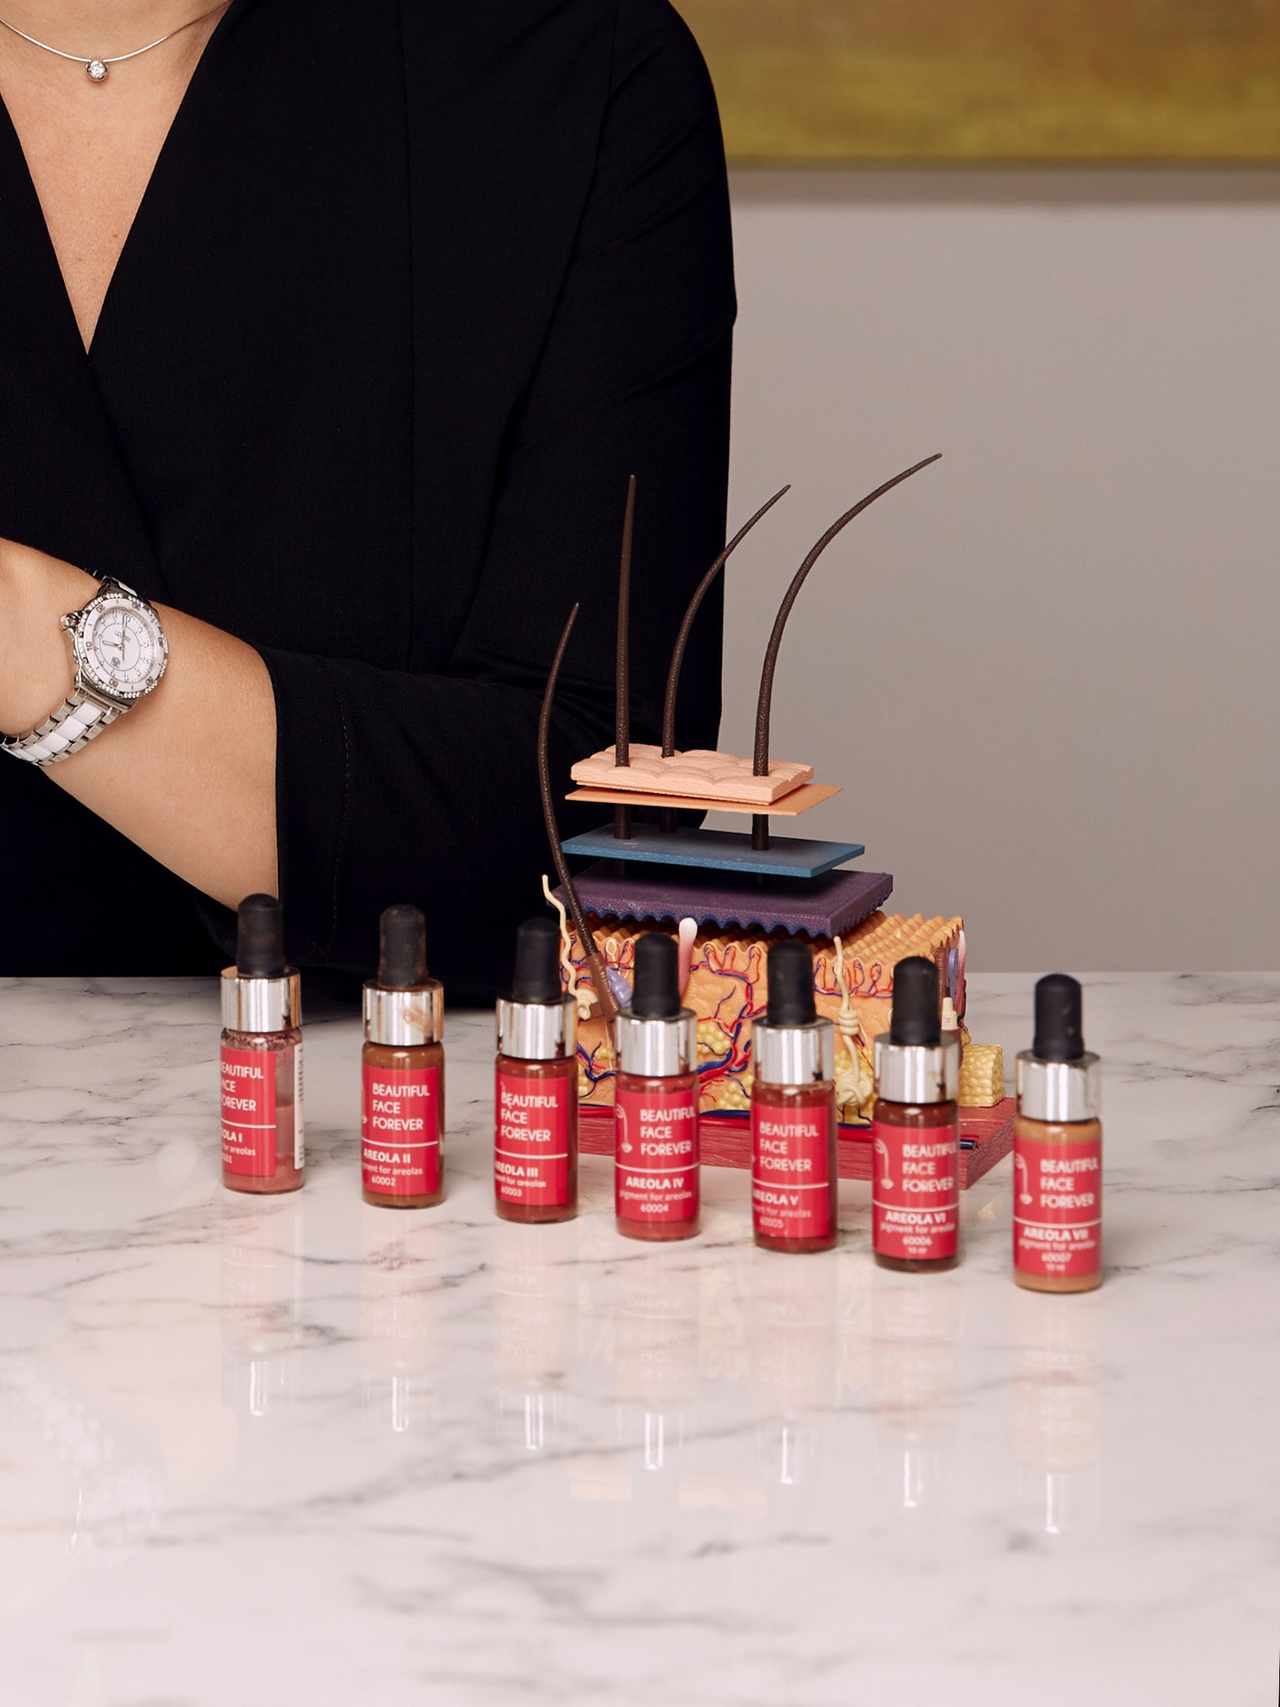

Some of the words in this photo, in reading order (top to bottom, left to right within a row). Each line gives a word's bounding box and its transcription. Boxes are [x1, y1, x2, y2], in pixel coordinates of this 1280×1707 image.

[221, 1061, 264, 1079] EAUTIFUL
[372, 1083, 431, 1098] BEAUTIFUL
[221, 1094, 257, 1112] OREVER
[372, 1100, 401, 1114] FACE
[501, 1091, 559, 1109] BEAUTIFUL
[500, 1107, 528, 1124] FACE
[640, 1106, 696, 1123] BEAUTIFUL
[372, 1116, 424, 1131] FOREVER
[759, 1120, 819, 1137] BEAUTIFUL
[500, 1124, 551, 1142] FOREVER
[640, 1126, 672, 1139] FACE
[640, 1140, 693, 1156] FOREVER
[759, 1138, 788, 1154] FACE
[363, 1148, 401, 1164] AREOLA
[402, 1153, 411, 1164] II
[760, 1155, 812, 1172] FOREVER
[379, 1165, 391, 1175] for
[392, 1167, 423, 1176] areolas
[526, 1167, 539, 1178] III
[902, 1161, 936, 1175] FACE
[1040, 1156, 1099, 1174] BEAUTIFUL
[371, 1175, 397, 1187] 60002
[625, 1176, 671, 1190] AREOLA
[672, 1177, 684, 1188] IV
[902, 1176, 954, 1192] FOREVER
[1040, 1175, 1075, 1191] FACE
[649, 1192, 663, 1202] for
[789, 1195, 799, 1206] V
[1040, 1191, 1095, 1209] FOREVER
[640, 1203, 669, 1213] 60004
[885, 1211, 933, 1225] AREOLA
[933, 1212, 946, 1223] VI
[1023, 1226, 1072, 1242] AREOLA
